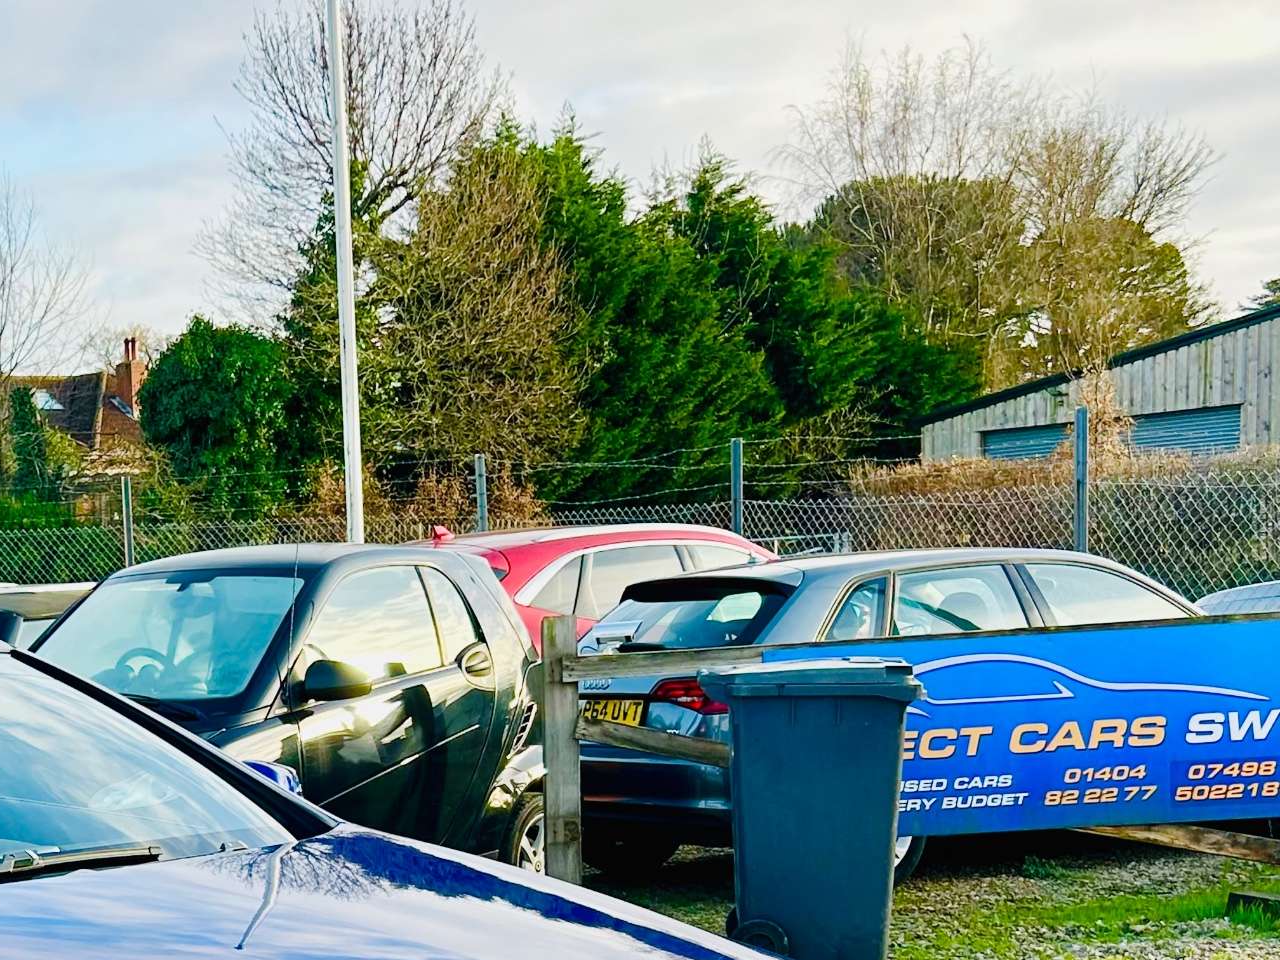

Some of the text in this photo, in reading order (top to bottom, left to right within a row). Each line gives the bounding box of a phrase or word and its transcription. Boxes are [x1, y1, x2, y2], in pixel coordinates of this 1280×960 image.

[578, 701, 642, 721] P64 UVT
[1008, 715, 1167, 754] CARS
[1185, 708, 1280, 744] SW
[1063, 764, 1147, 785] 01404
[1187, 760, 1277, 780] 07498
[953, 774, 1013, 790] CARS
[1174, 781, 1280, 801] 502218
[941, 792, 1029, 809] BUDGET
[1044, 785, 1158, 806] 82 22 77
